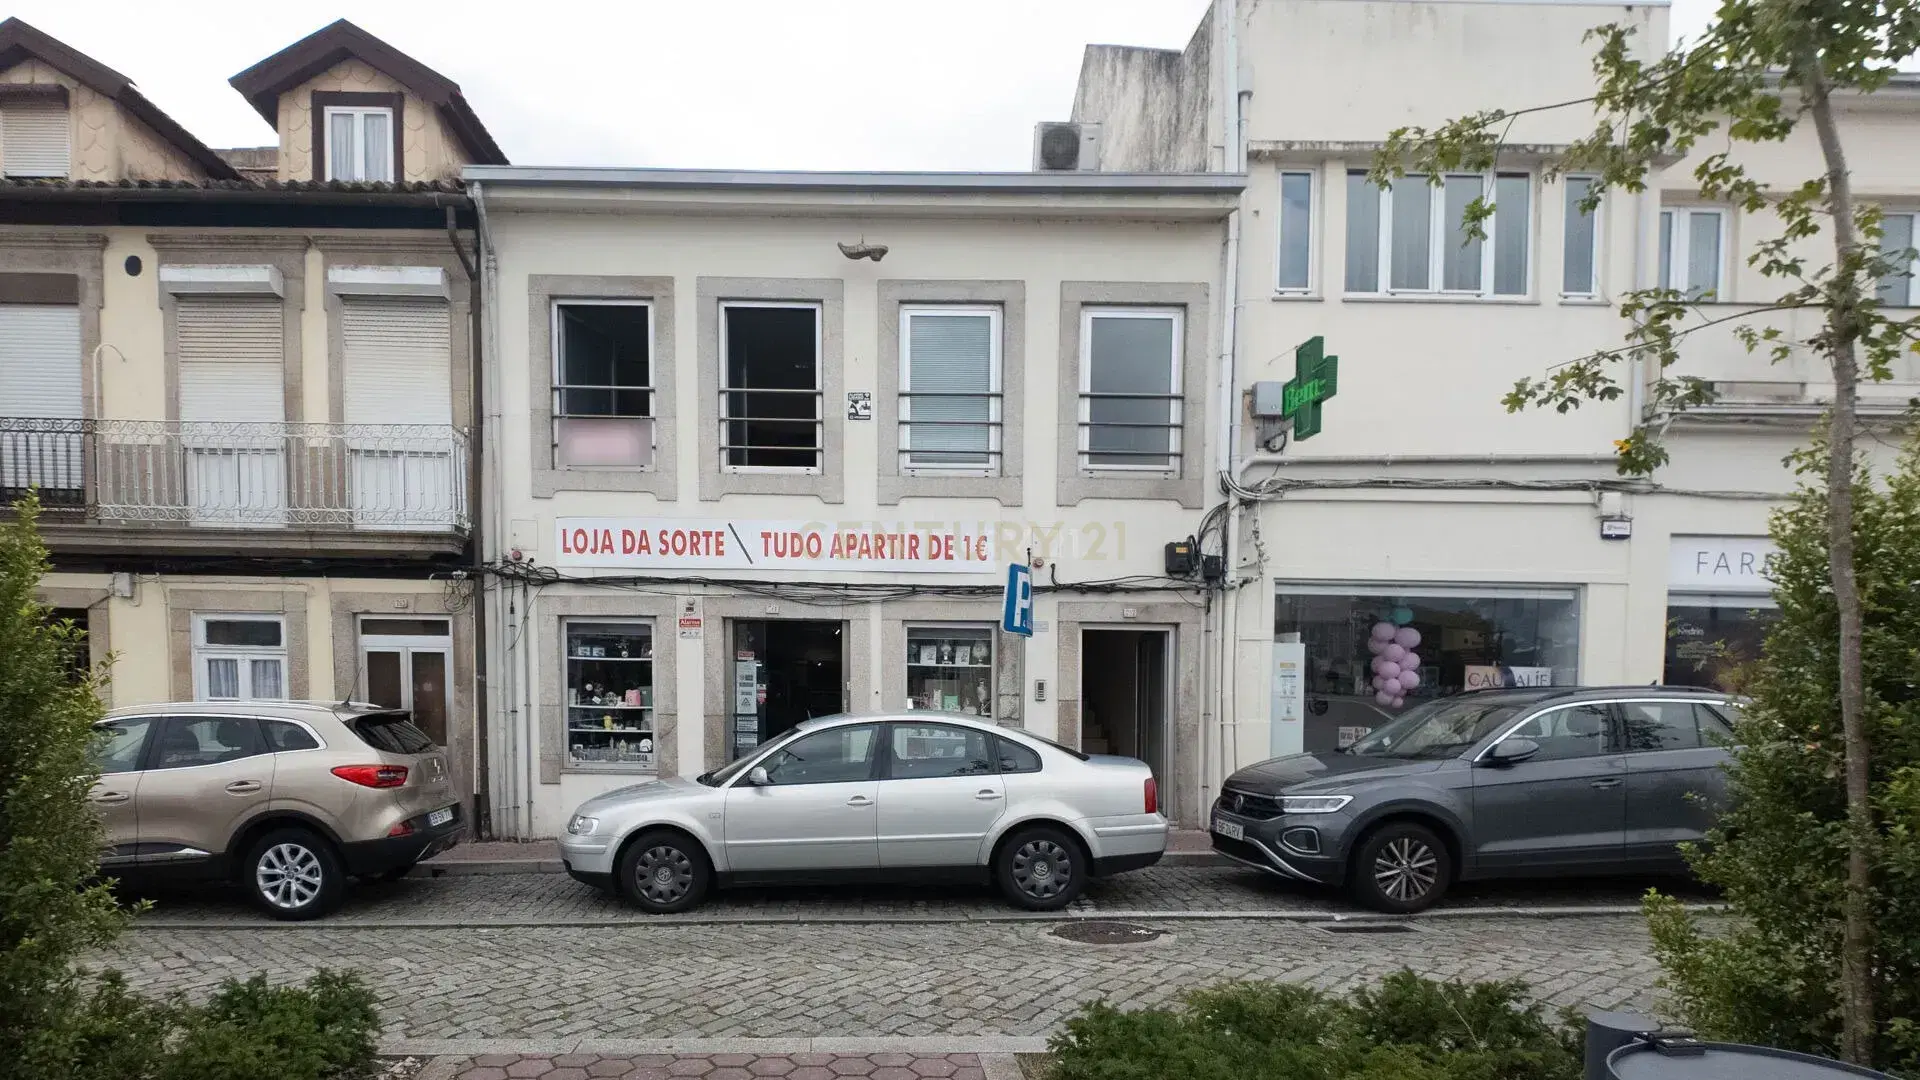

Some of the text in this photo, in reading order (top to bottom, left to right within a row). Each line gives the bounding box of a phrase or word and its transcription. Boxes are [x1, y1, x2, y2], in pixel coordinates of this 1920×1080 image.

[562, 528, 988, 561] LOJA DA SORTE TUDO APARTIR DE 1€
[1013, 572, 1031, 627] P
[1467, 670, 1549, 688] CAUALÍE
